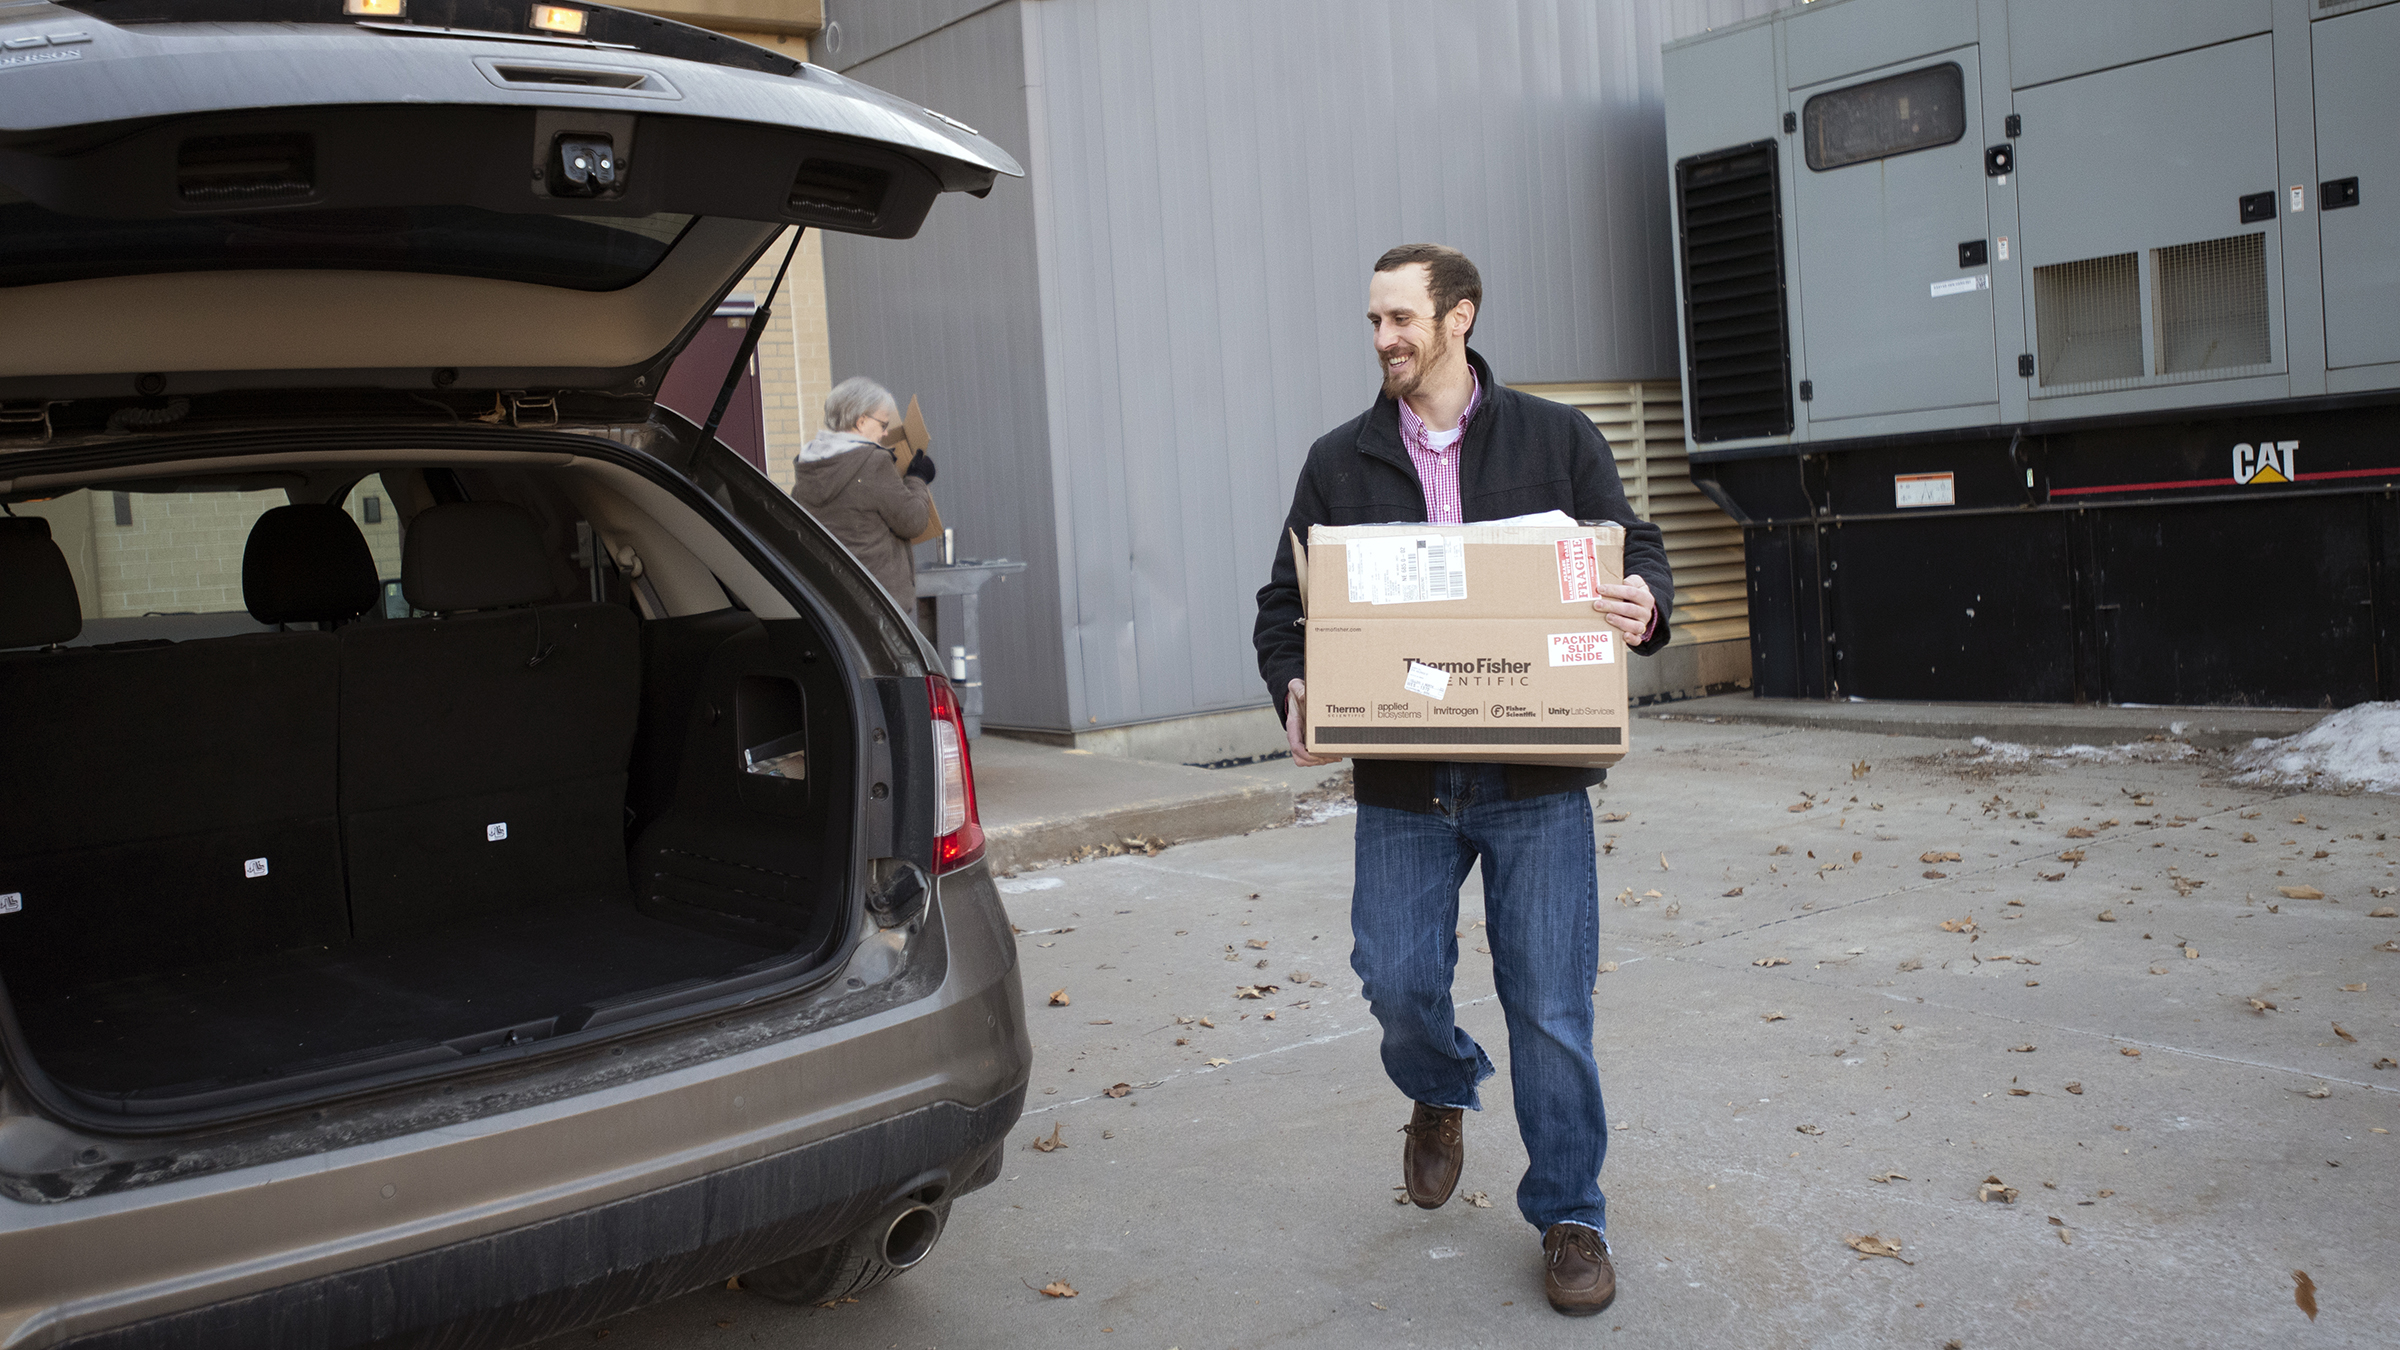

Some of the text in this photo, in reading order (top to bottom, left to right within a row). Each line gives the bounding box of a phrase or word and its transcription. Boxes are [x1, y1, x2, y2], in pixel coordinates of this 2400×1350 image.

[2232, 440, 2299, 485] CAT
[1573, 539, 1589, 599] FRAGILE
[1554, 634, 1608, 645] PACKING
[1568, 644, 1595, 653] SLIP
[1562, 652, 1603, 662] INSIDE
[1447, 677, 1529, 686] ENTIFIC
[1326, 704, 1366, 713] Thermo
[1378, 702, 1409, 711] applied
[1434, 706, 1479, 716] invitrogen
[1378, 711, 1422, 720] biosystems
